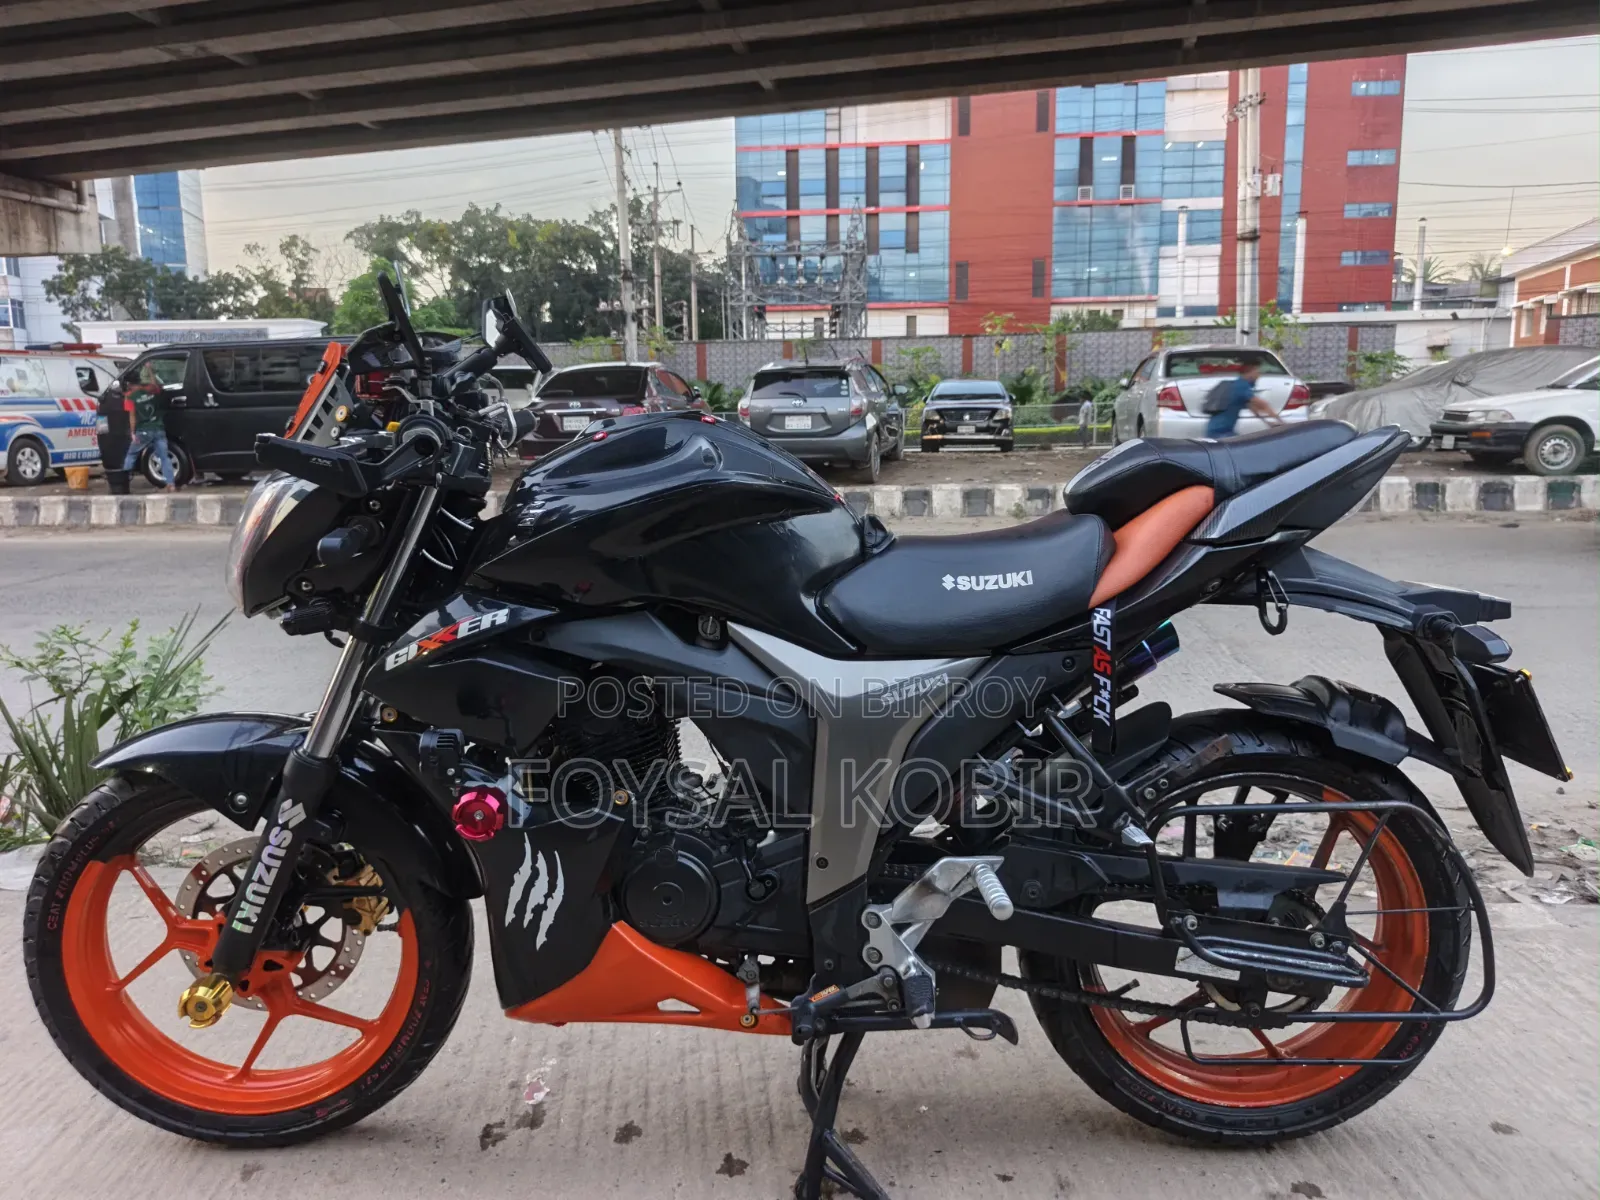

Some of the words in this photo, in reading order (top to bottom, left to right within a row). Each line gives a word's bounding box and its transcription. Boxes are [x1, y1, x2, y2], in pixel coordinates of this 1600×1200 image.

[956, 569, 1034, 591] SUZUKI
[385, 608, 510, 672] GIXXER
[1093, 606, 1112, 651] FAST
[1093, 644, 1112, 676] AS
[880, 672, 950, 706] SUZUKI
[232, 825, 293, 934] SUZUKI
